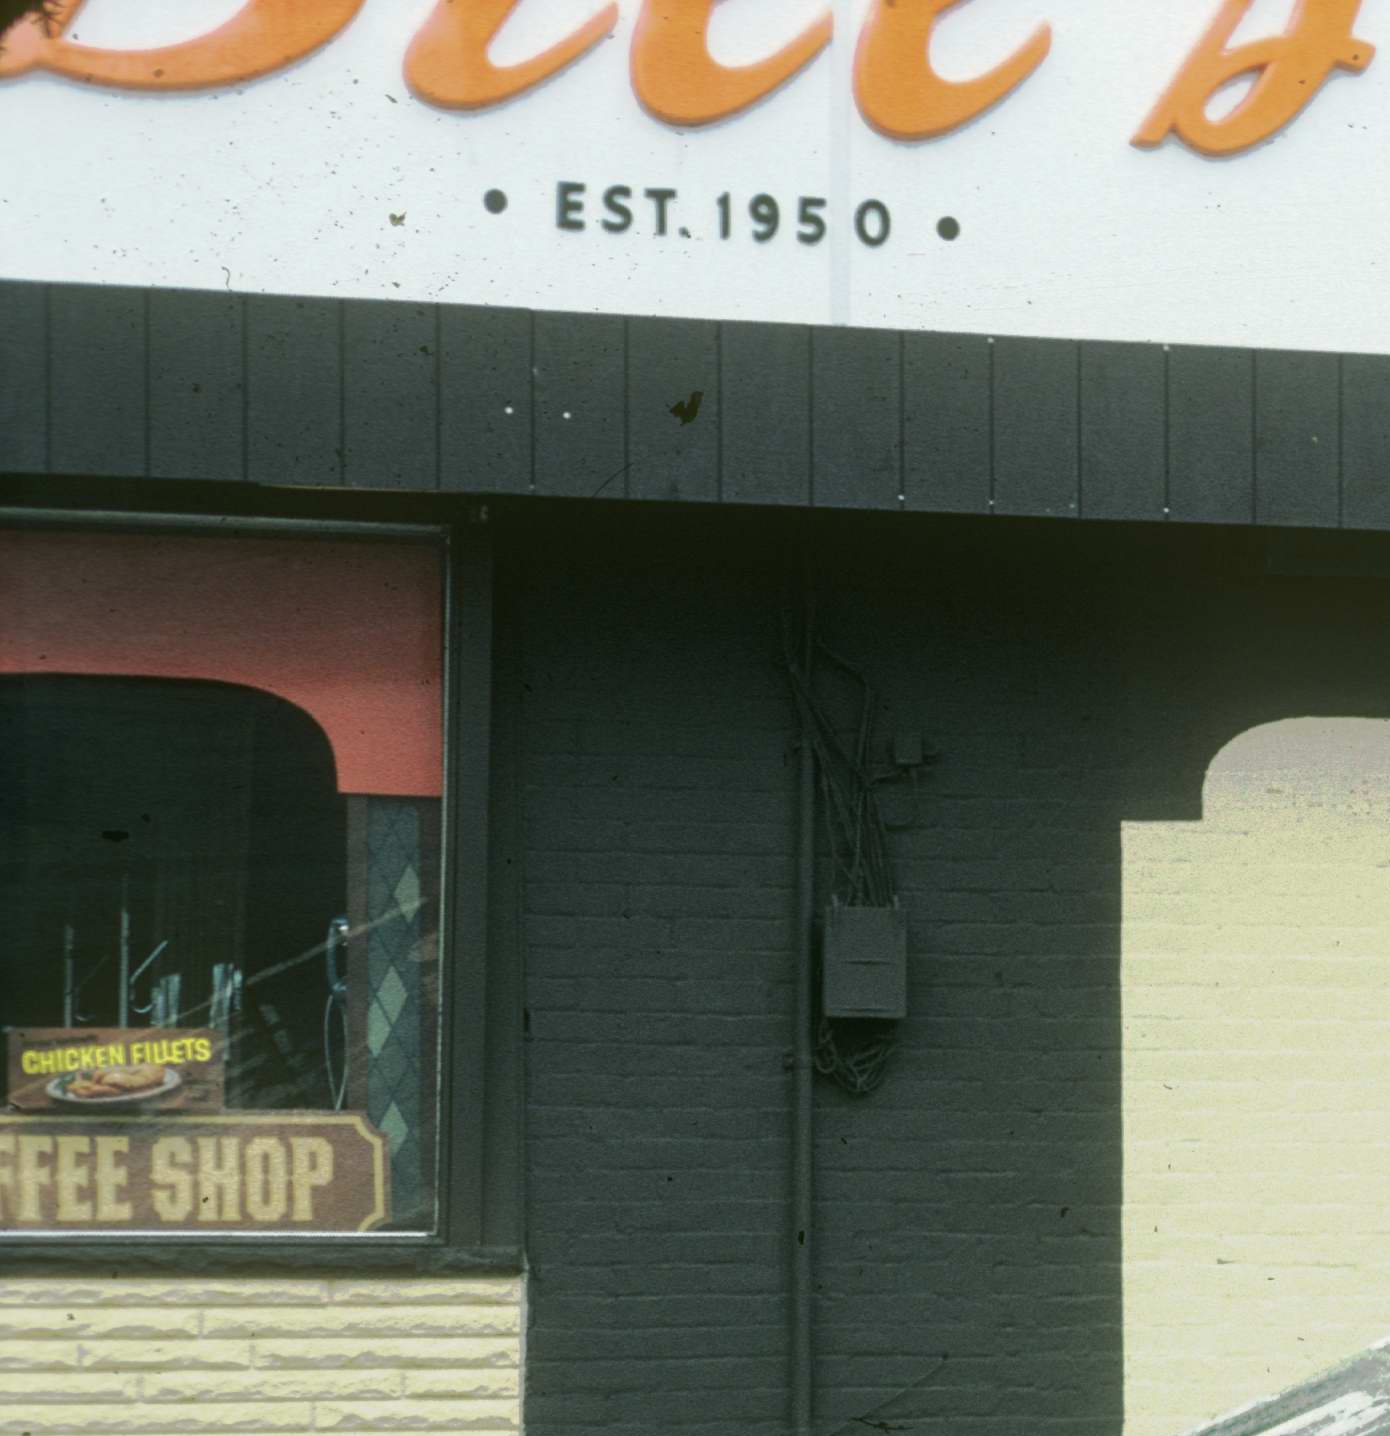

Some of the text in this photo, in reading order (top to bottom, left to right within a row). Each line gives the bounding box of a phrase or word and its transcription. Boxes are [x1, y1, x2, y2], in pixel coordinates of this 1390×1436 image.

[21, 1044, 126, 1075] CHICKEN
[129, 1037, 212, 1065] FILLETS
[151, 1135, 334, 1222] SHOP
